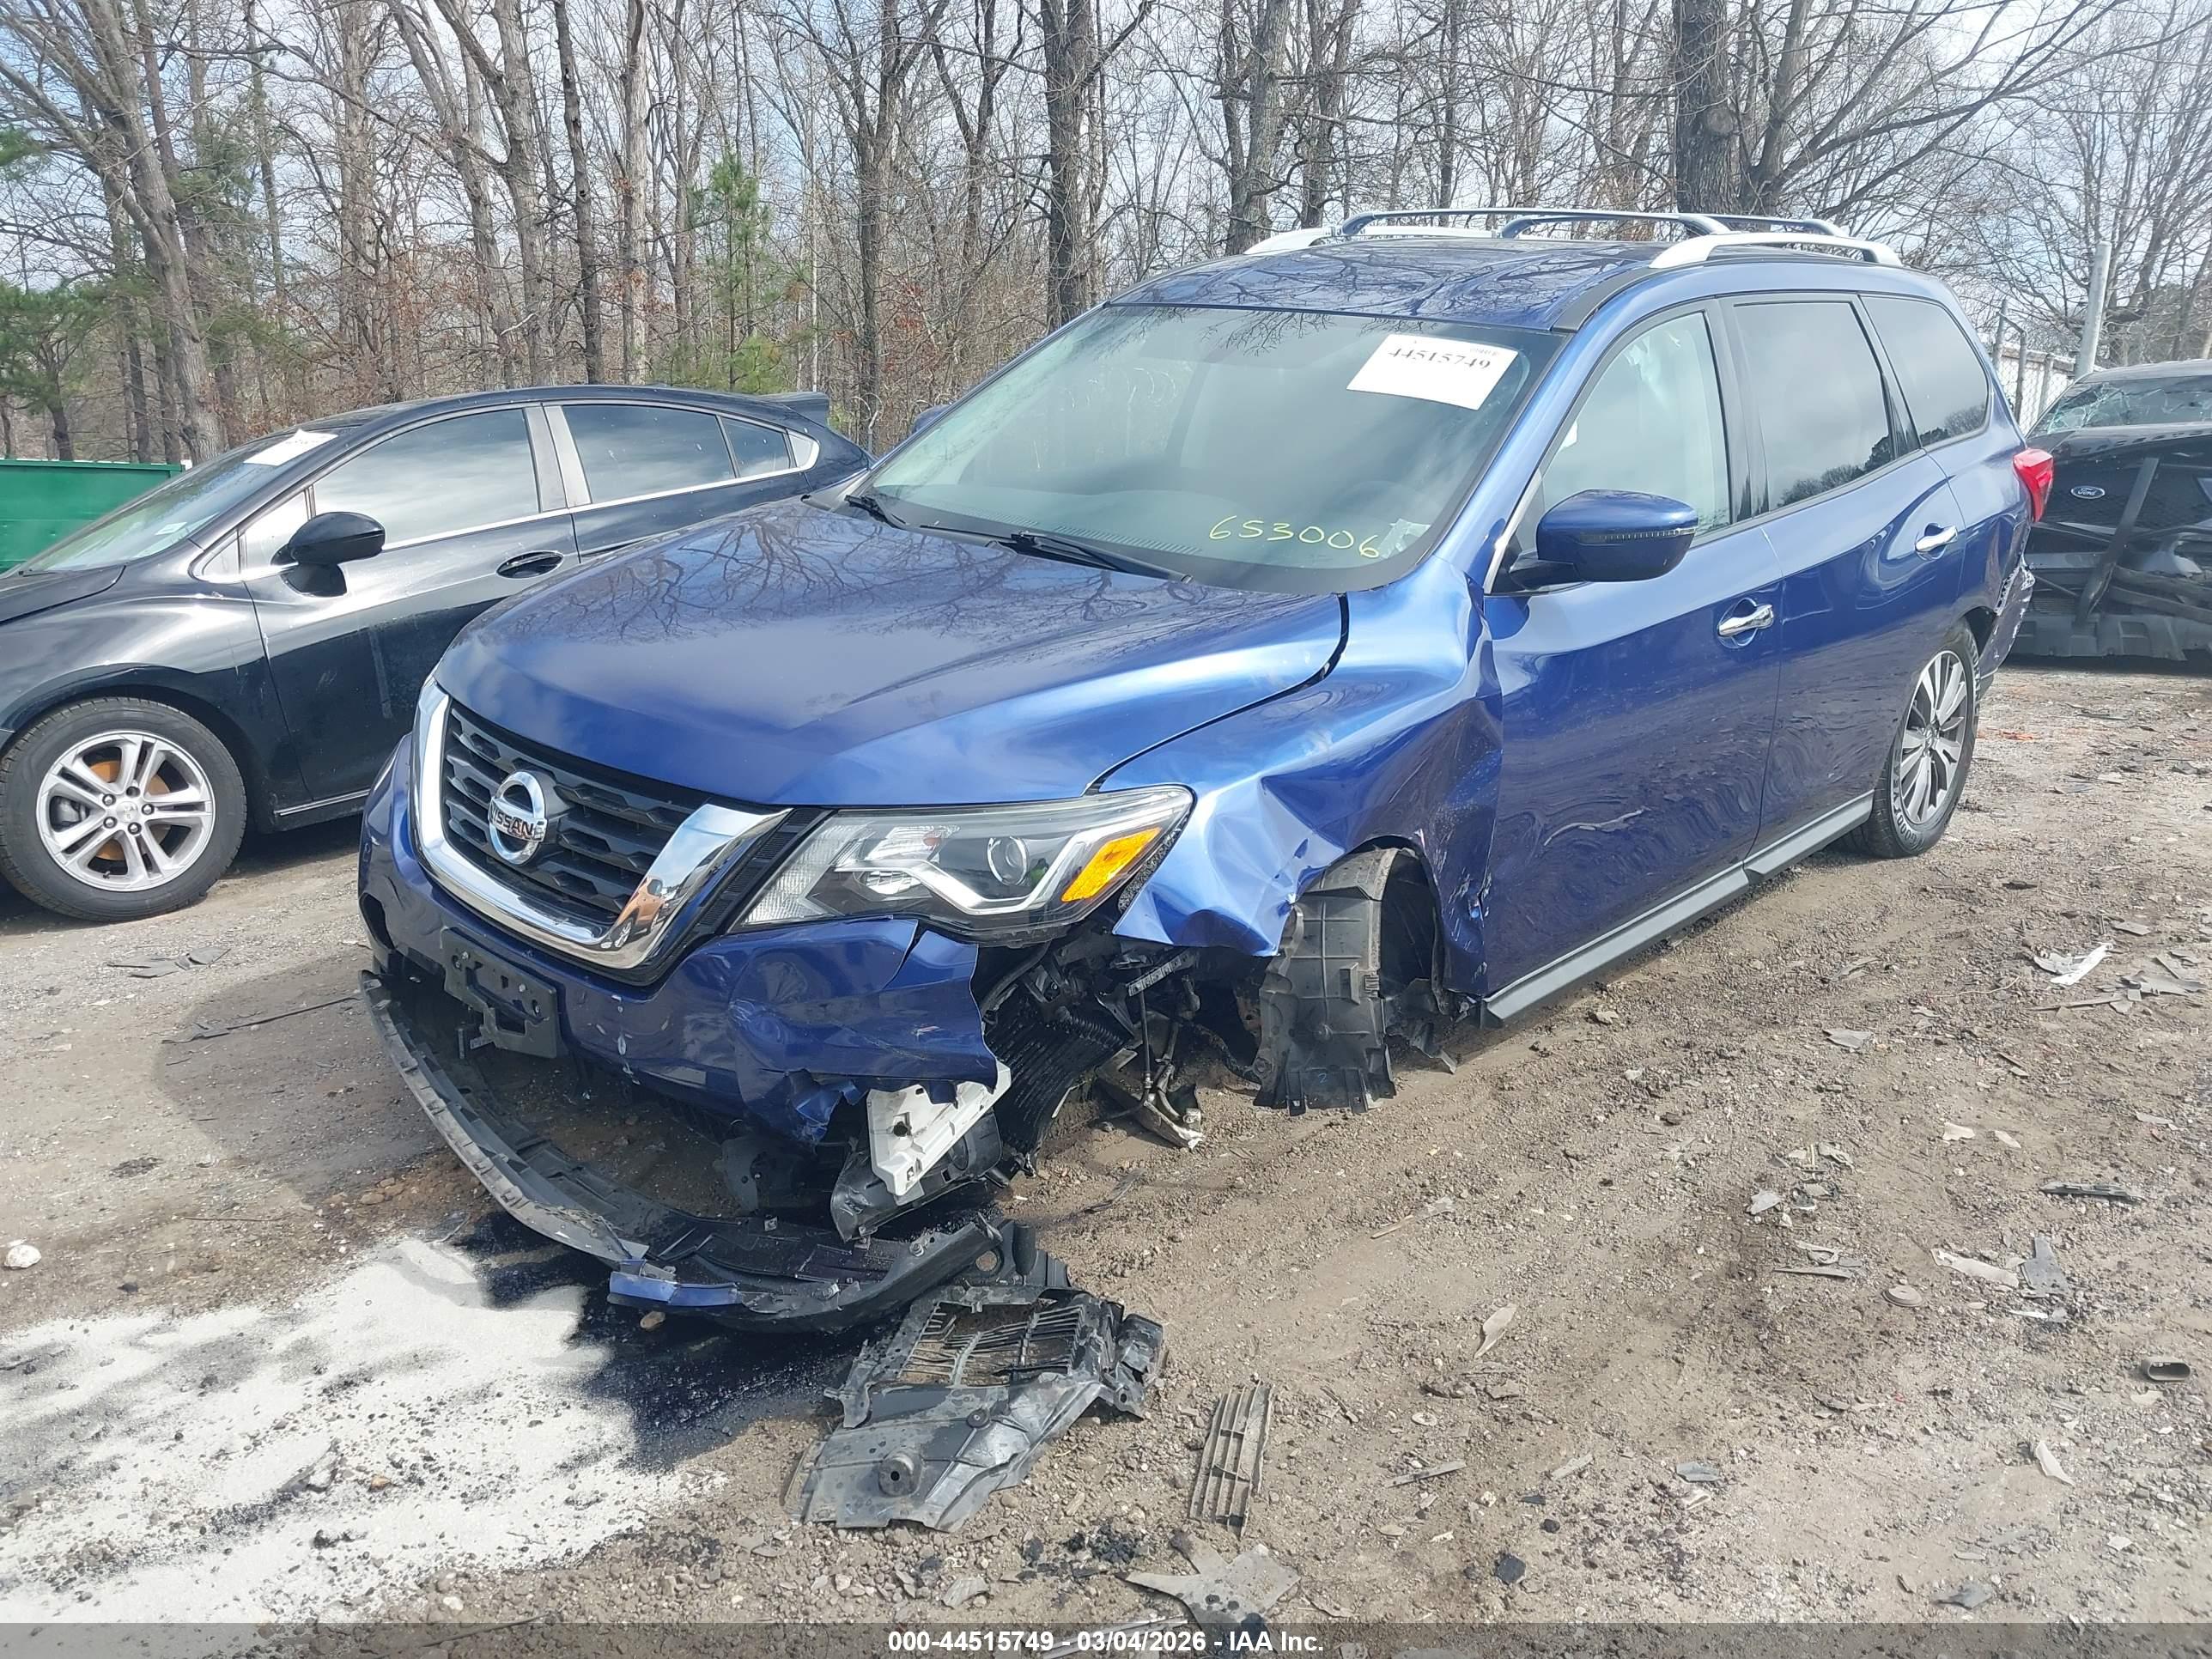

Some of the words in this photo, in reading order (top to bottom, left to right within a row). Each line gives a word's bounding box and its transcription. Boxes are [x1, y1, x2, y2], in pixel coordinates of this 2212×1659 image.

[1388, 348, 1491, 368] 44515749
[1208, 515, 1379, 558] 653006
[489, 800, 535, 837] NISSAN
